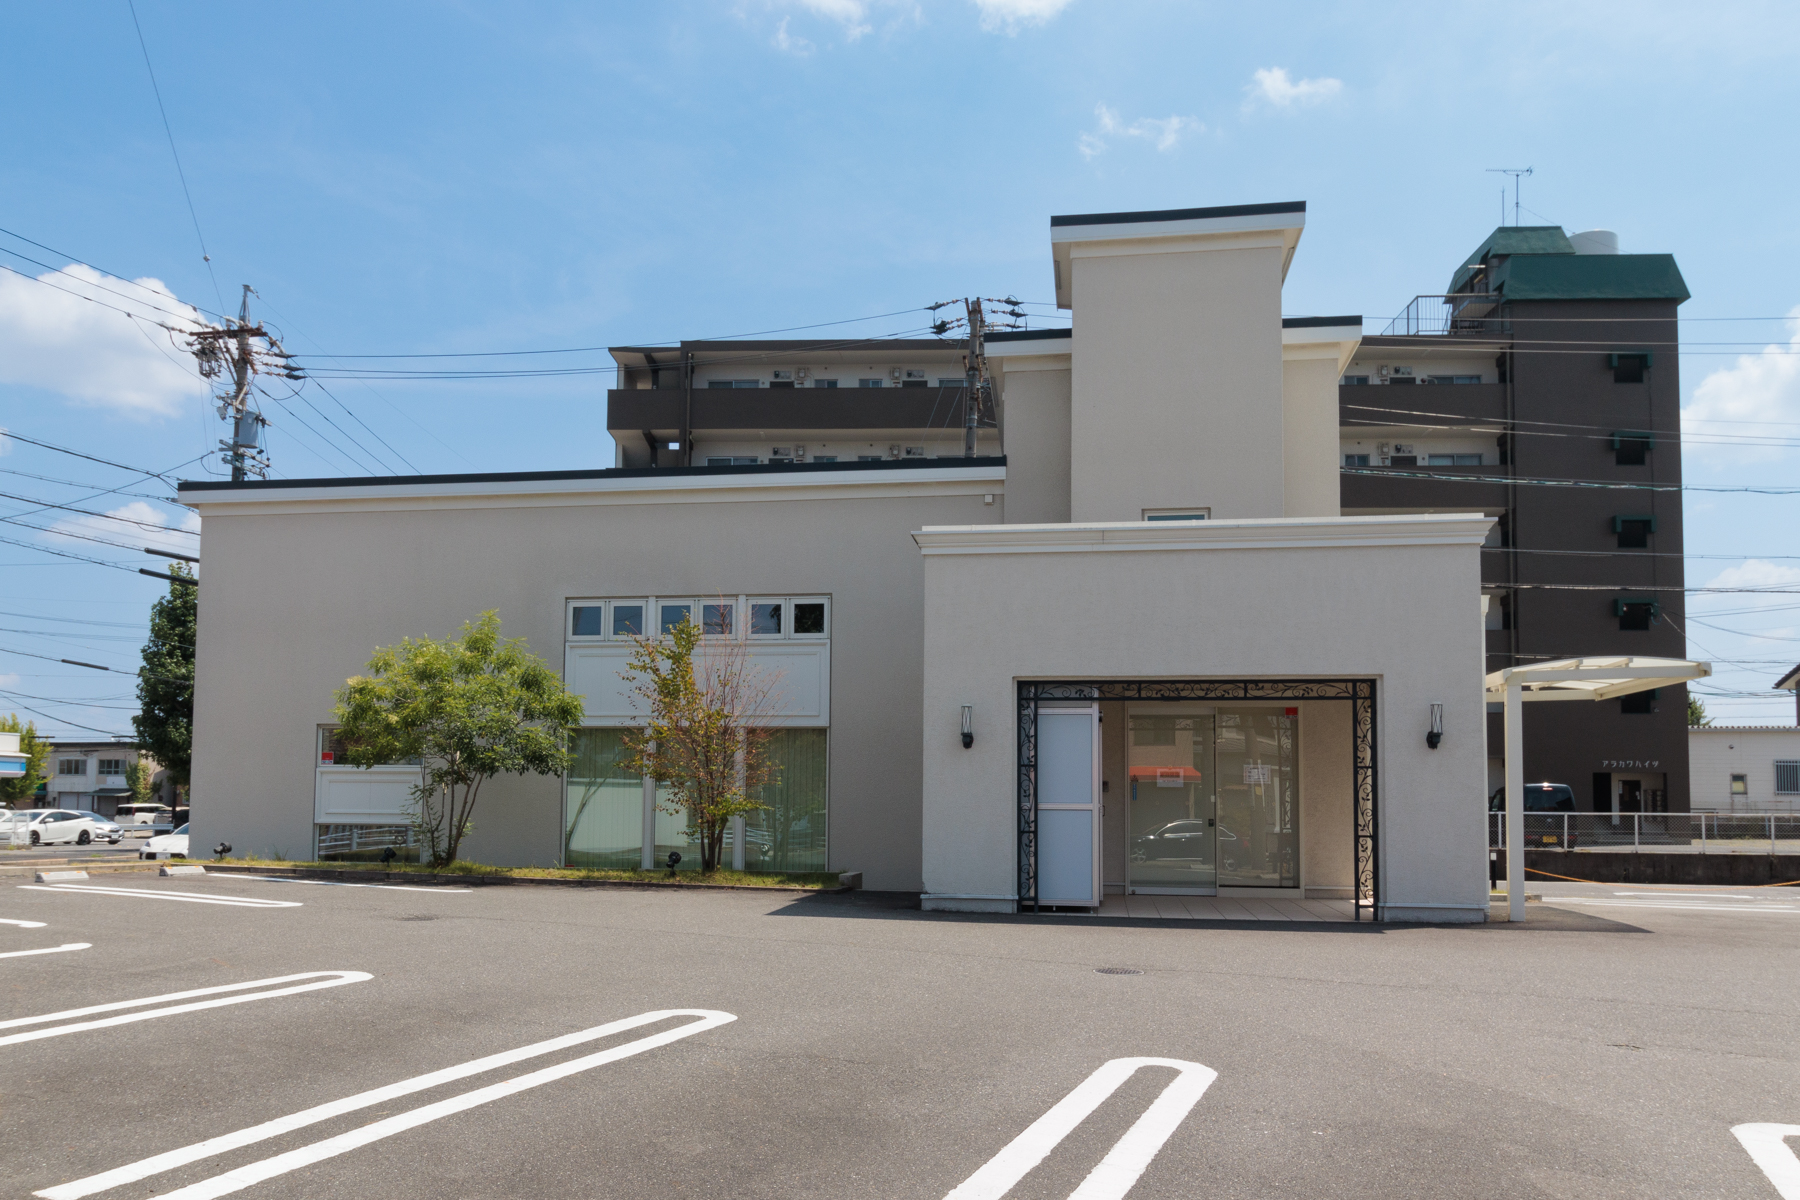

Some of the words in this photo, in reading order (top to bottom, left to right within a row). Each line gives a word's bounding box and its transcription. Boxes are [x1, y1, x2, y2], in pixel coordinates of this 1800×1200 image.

[1602, 760, 1659, 768] アラカワハイツ
